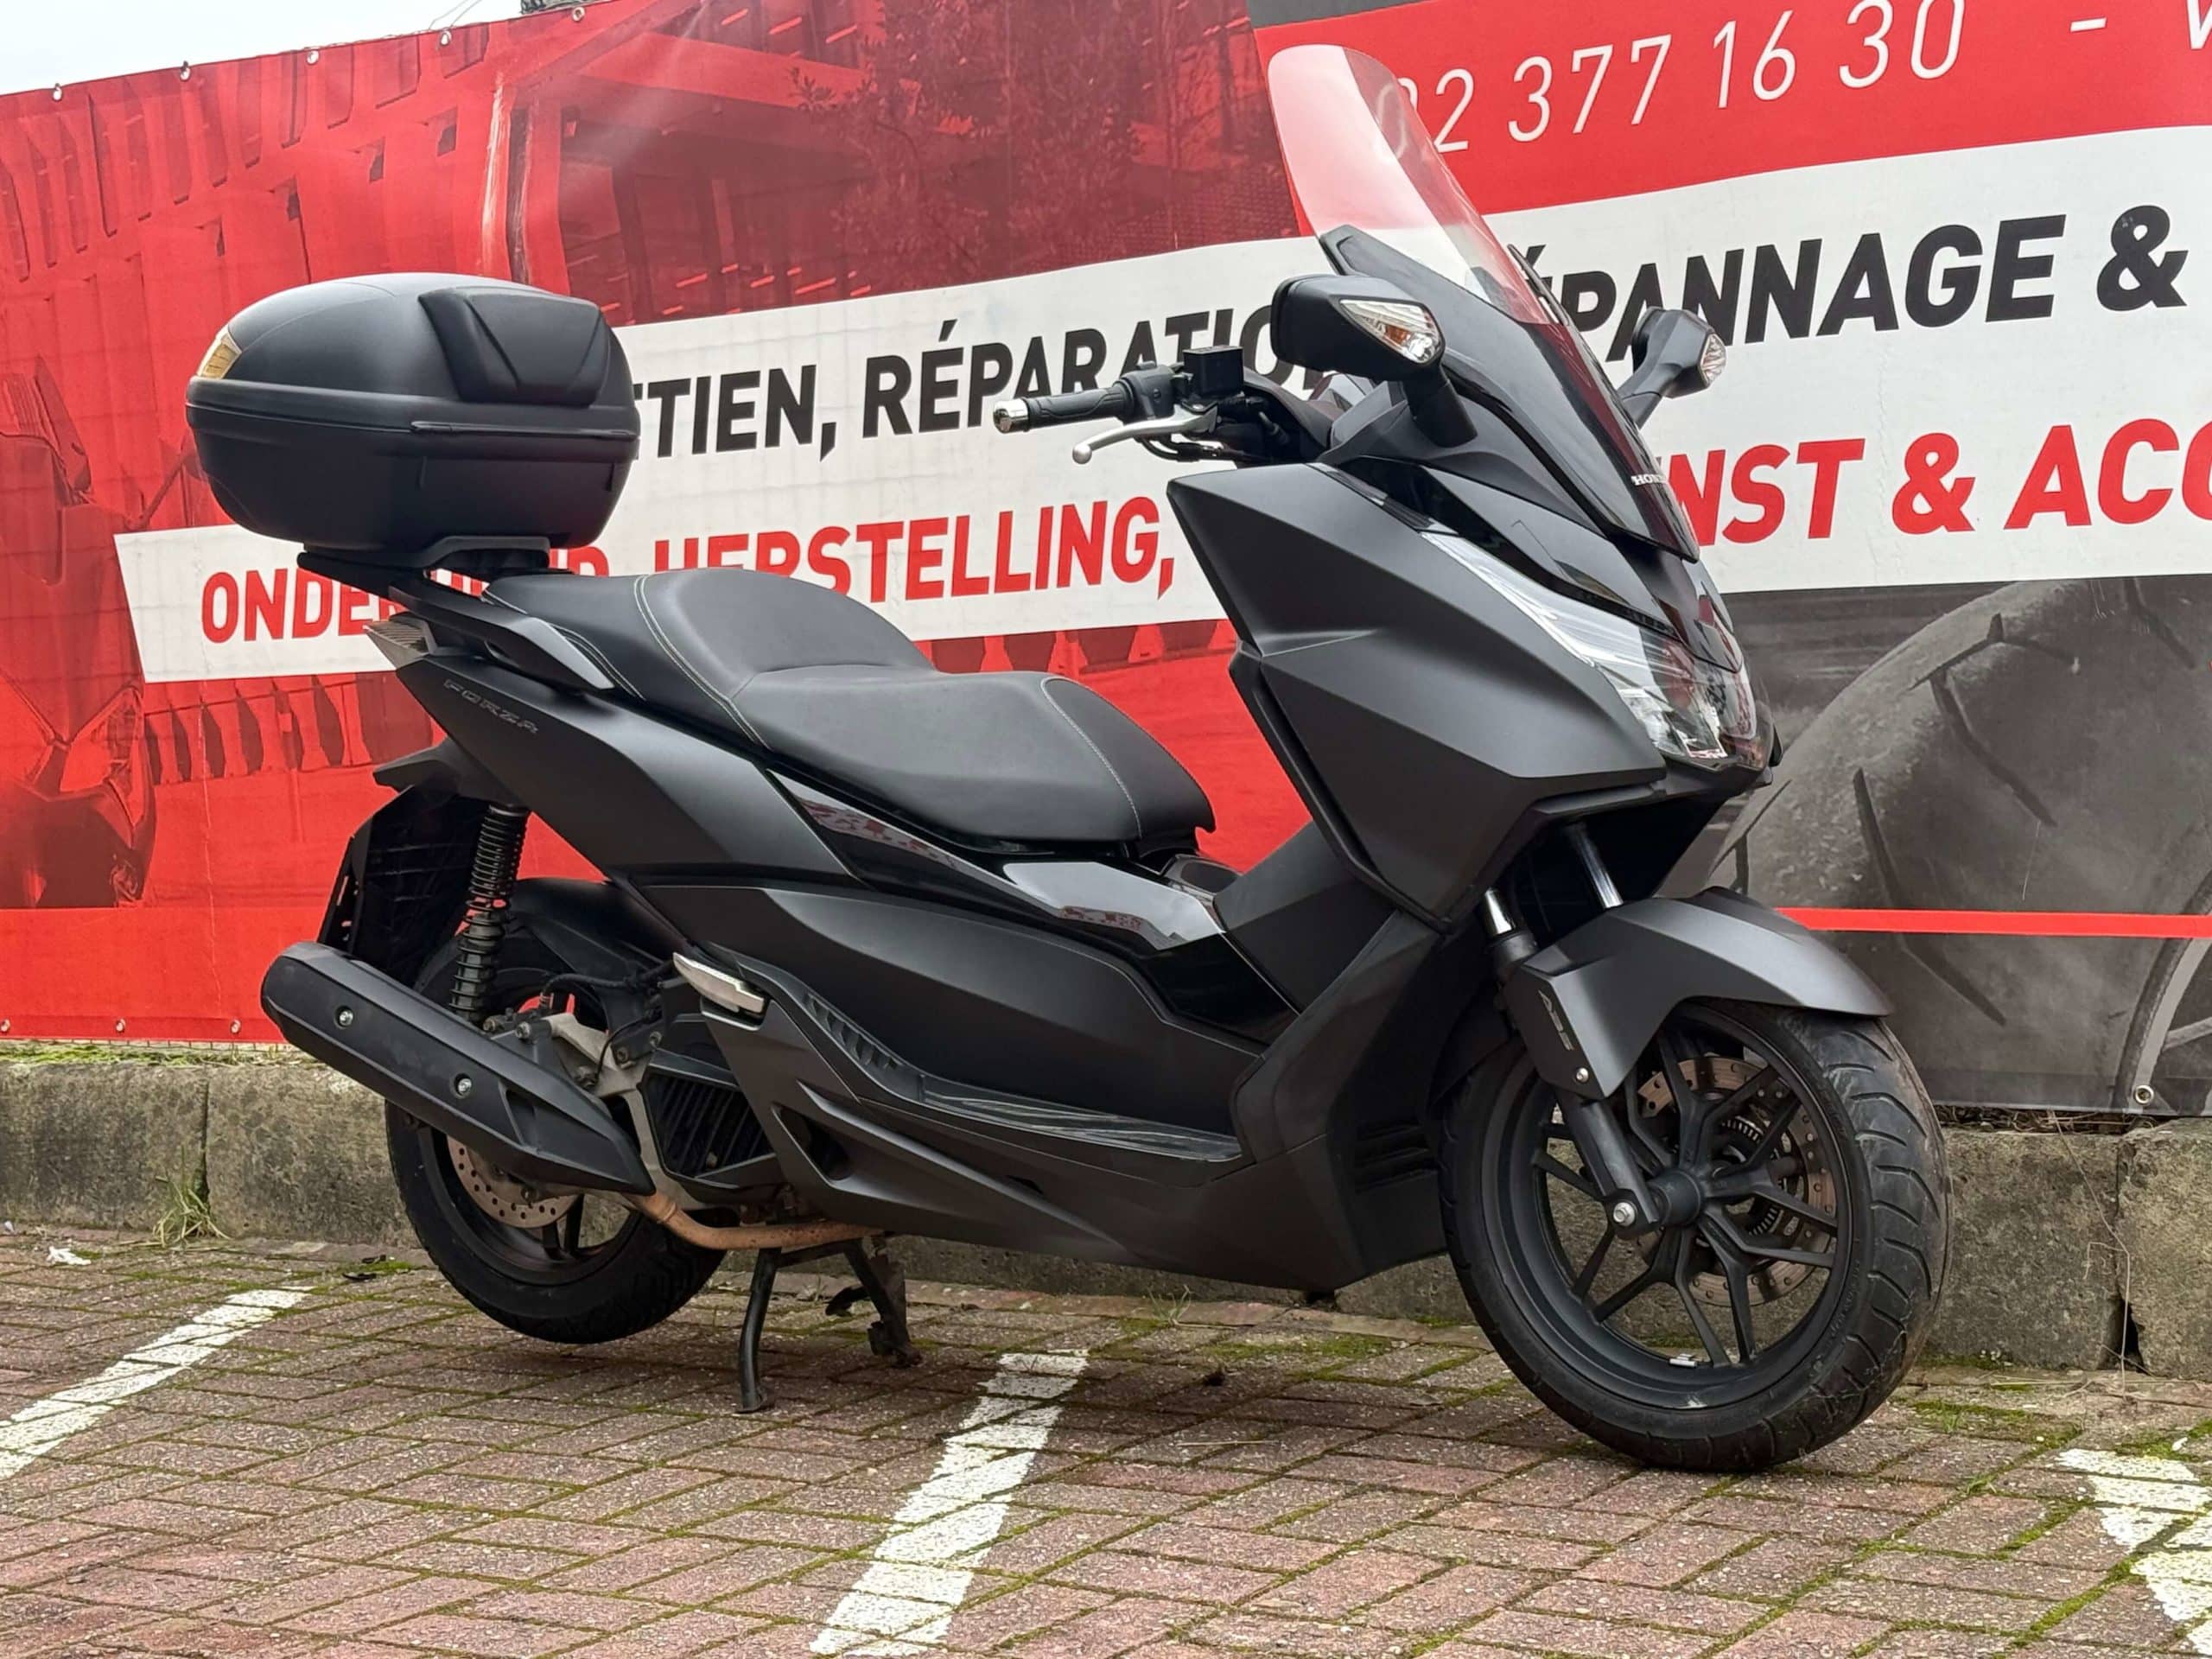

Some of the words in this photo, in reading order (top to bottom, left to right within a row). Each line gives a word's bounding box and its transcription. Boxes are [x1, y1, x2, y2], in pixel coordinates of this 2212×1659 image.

[1377, 68, 1475, 154] 02
[1507, 33, 1672, 143] 377
[1712, 9, 1796, 109] 16
[1838, 0, 1966, 89] 30
[632, 364, 837, 462] TIEN,
[862, 304, 1325, 439] RÉPARATO
[1522, 213, 2067, 363] PANNAGE
[2096, 204, 2189, 312] &
[1656, 437, 1866, 547] NST
[1891, 432, 1976, 535] &
[442, 678, 539, 734] FORZA
